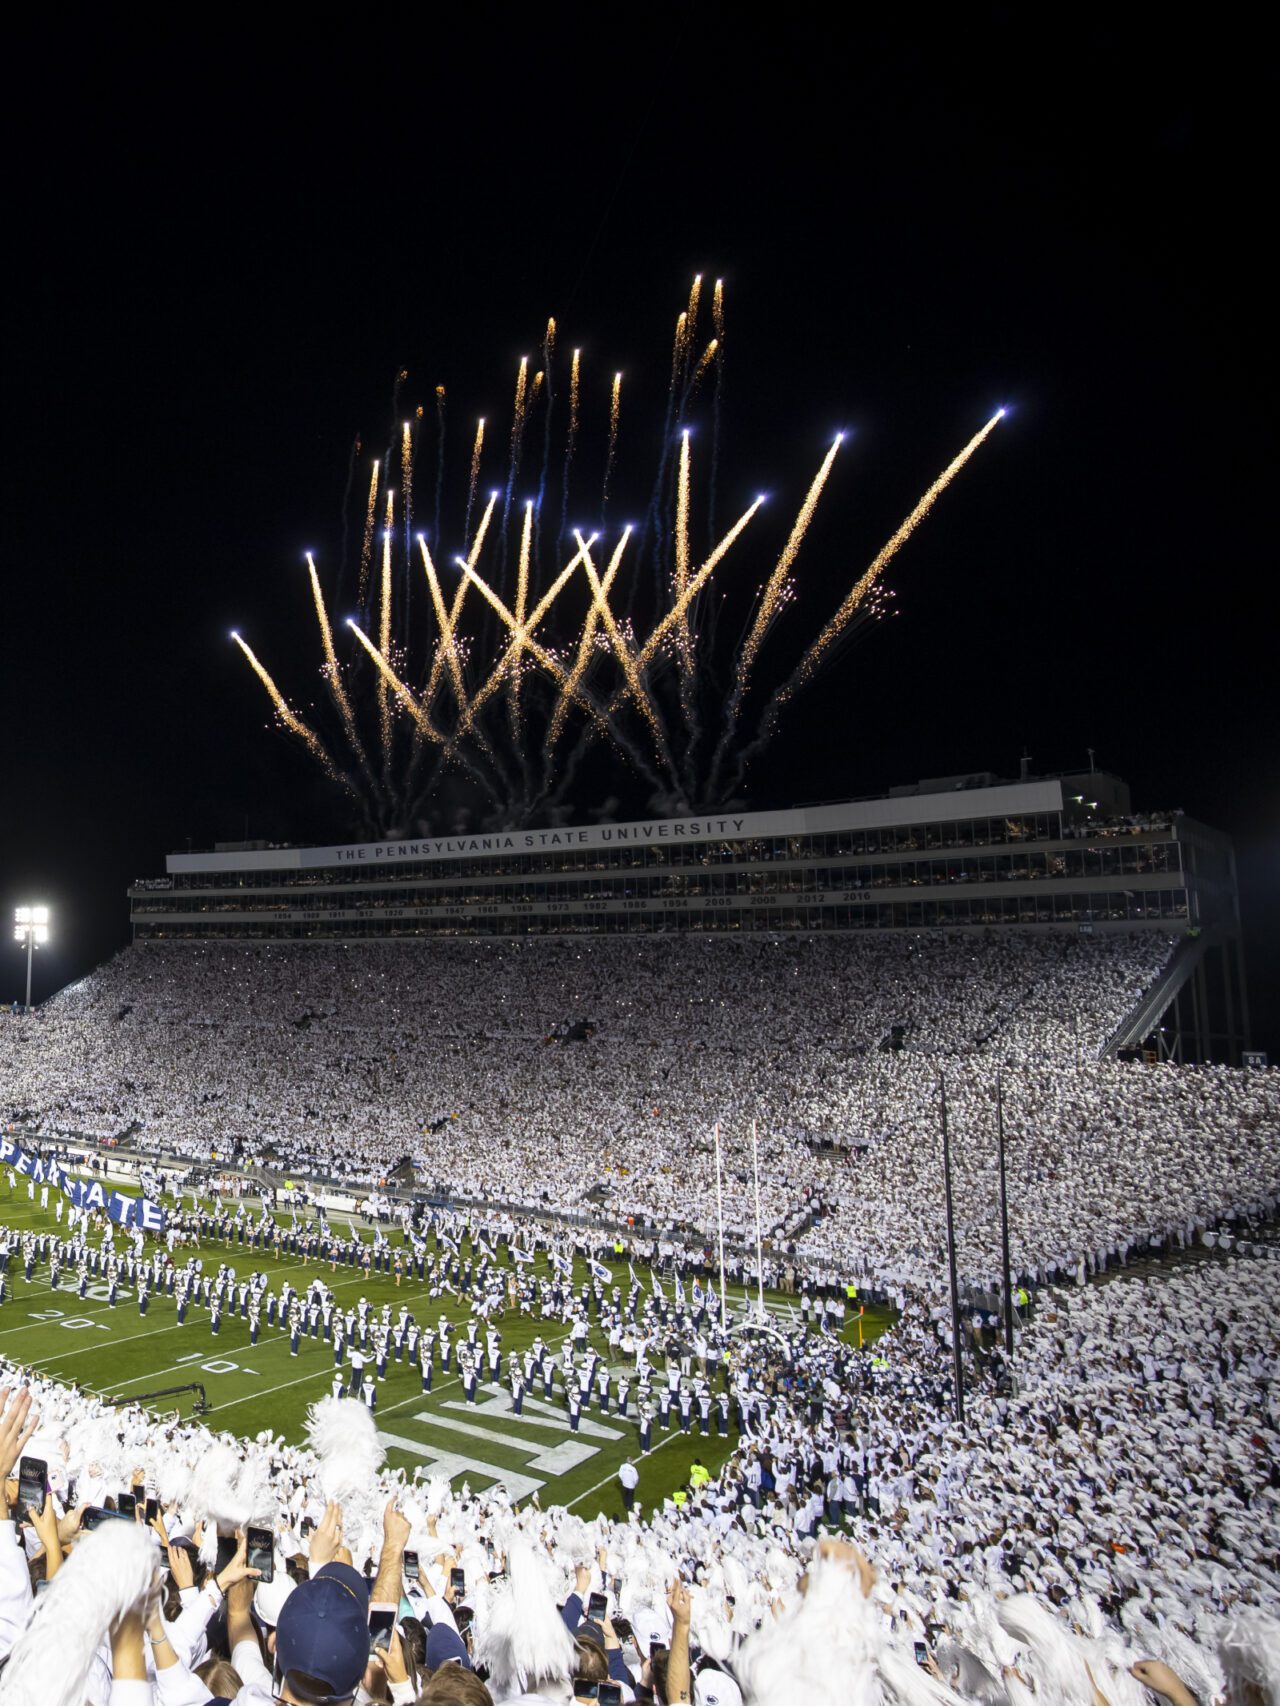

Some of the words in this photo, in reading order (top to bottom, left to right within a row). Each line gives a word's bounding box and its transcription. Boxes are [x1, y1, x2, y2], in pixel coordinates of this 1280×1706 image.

[336, 848, 366, 861] THE
[375, 837, 514, 858] PENNSYLVANIA
[524, 831, 589, 847] STATE
[601, 819, 745, 841] UNIVERSITY
[328, 910, 345, 918] 1911
[384, 909, 403, 917] 1920
[414, 908, 433, 916] 1921
[445, 906, 465, 915] 1947
[477, 905, 498, 914] 1968
[511, 904, 533, 912] 1969
[546, 903, 569, 911] 1973
[583, 902, 607, 911] 1982
[622, 901, 647, 909] 1986
[663, 899, 688, 908] 1994
[704, 897, 733, 907] 2005
[750, 896, 776, 905] 2008
[796, 894, 825, 903] 2012
[843, 892, 871, 901] 2016
[63, 1175, 164, 1231] STATE
[28, 1310, 96, 1330] 20
[176, 1353, 239, 1375] 10
